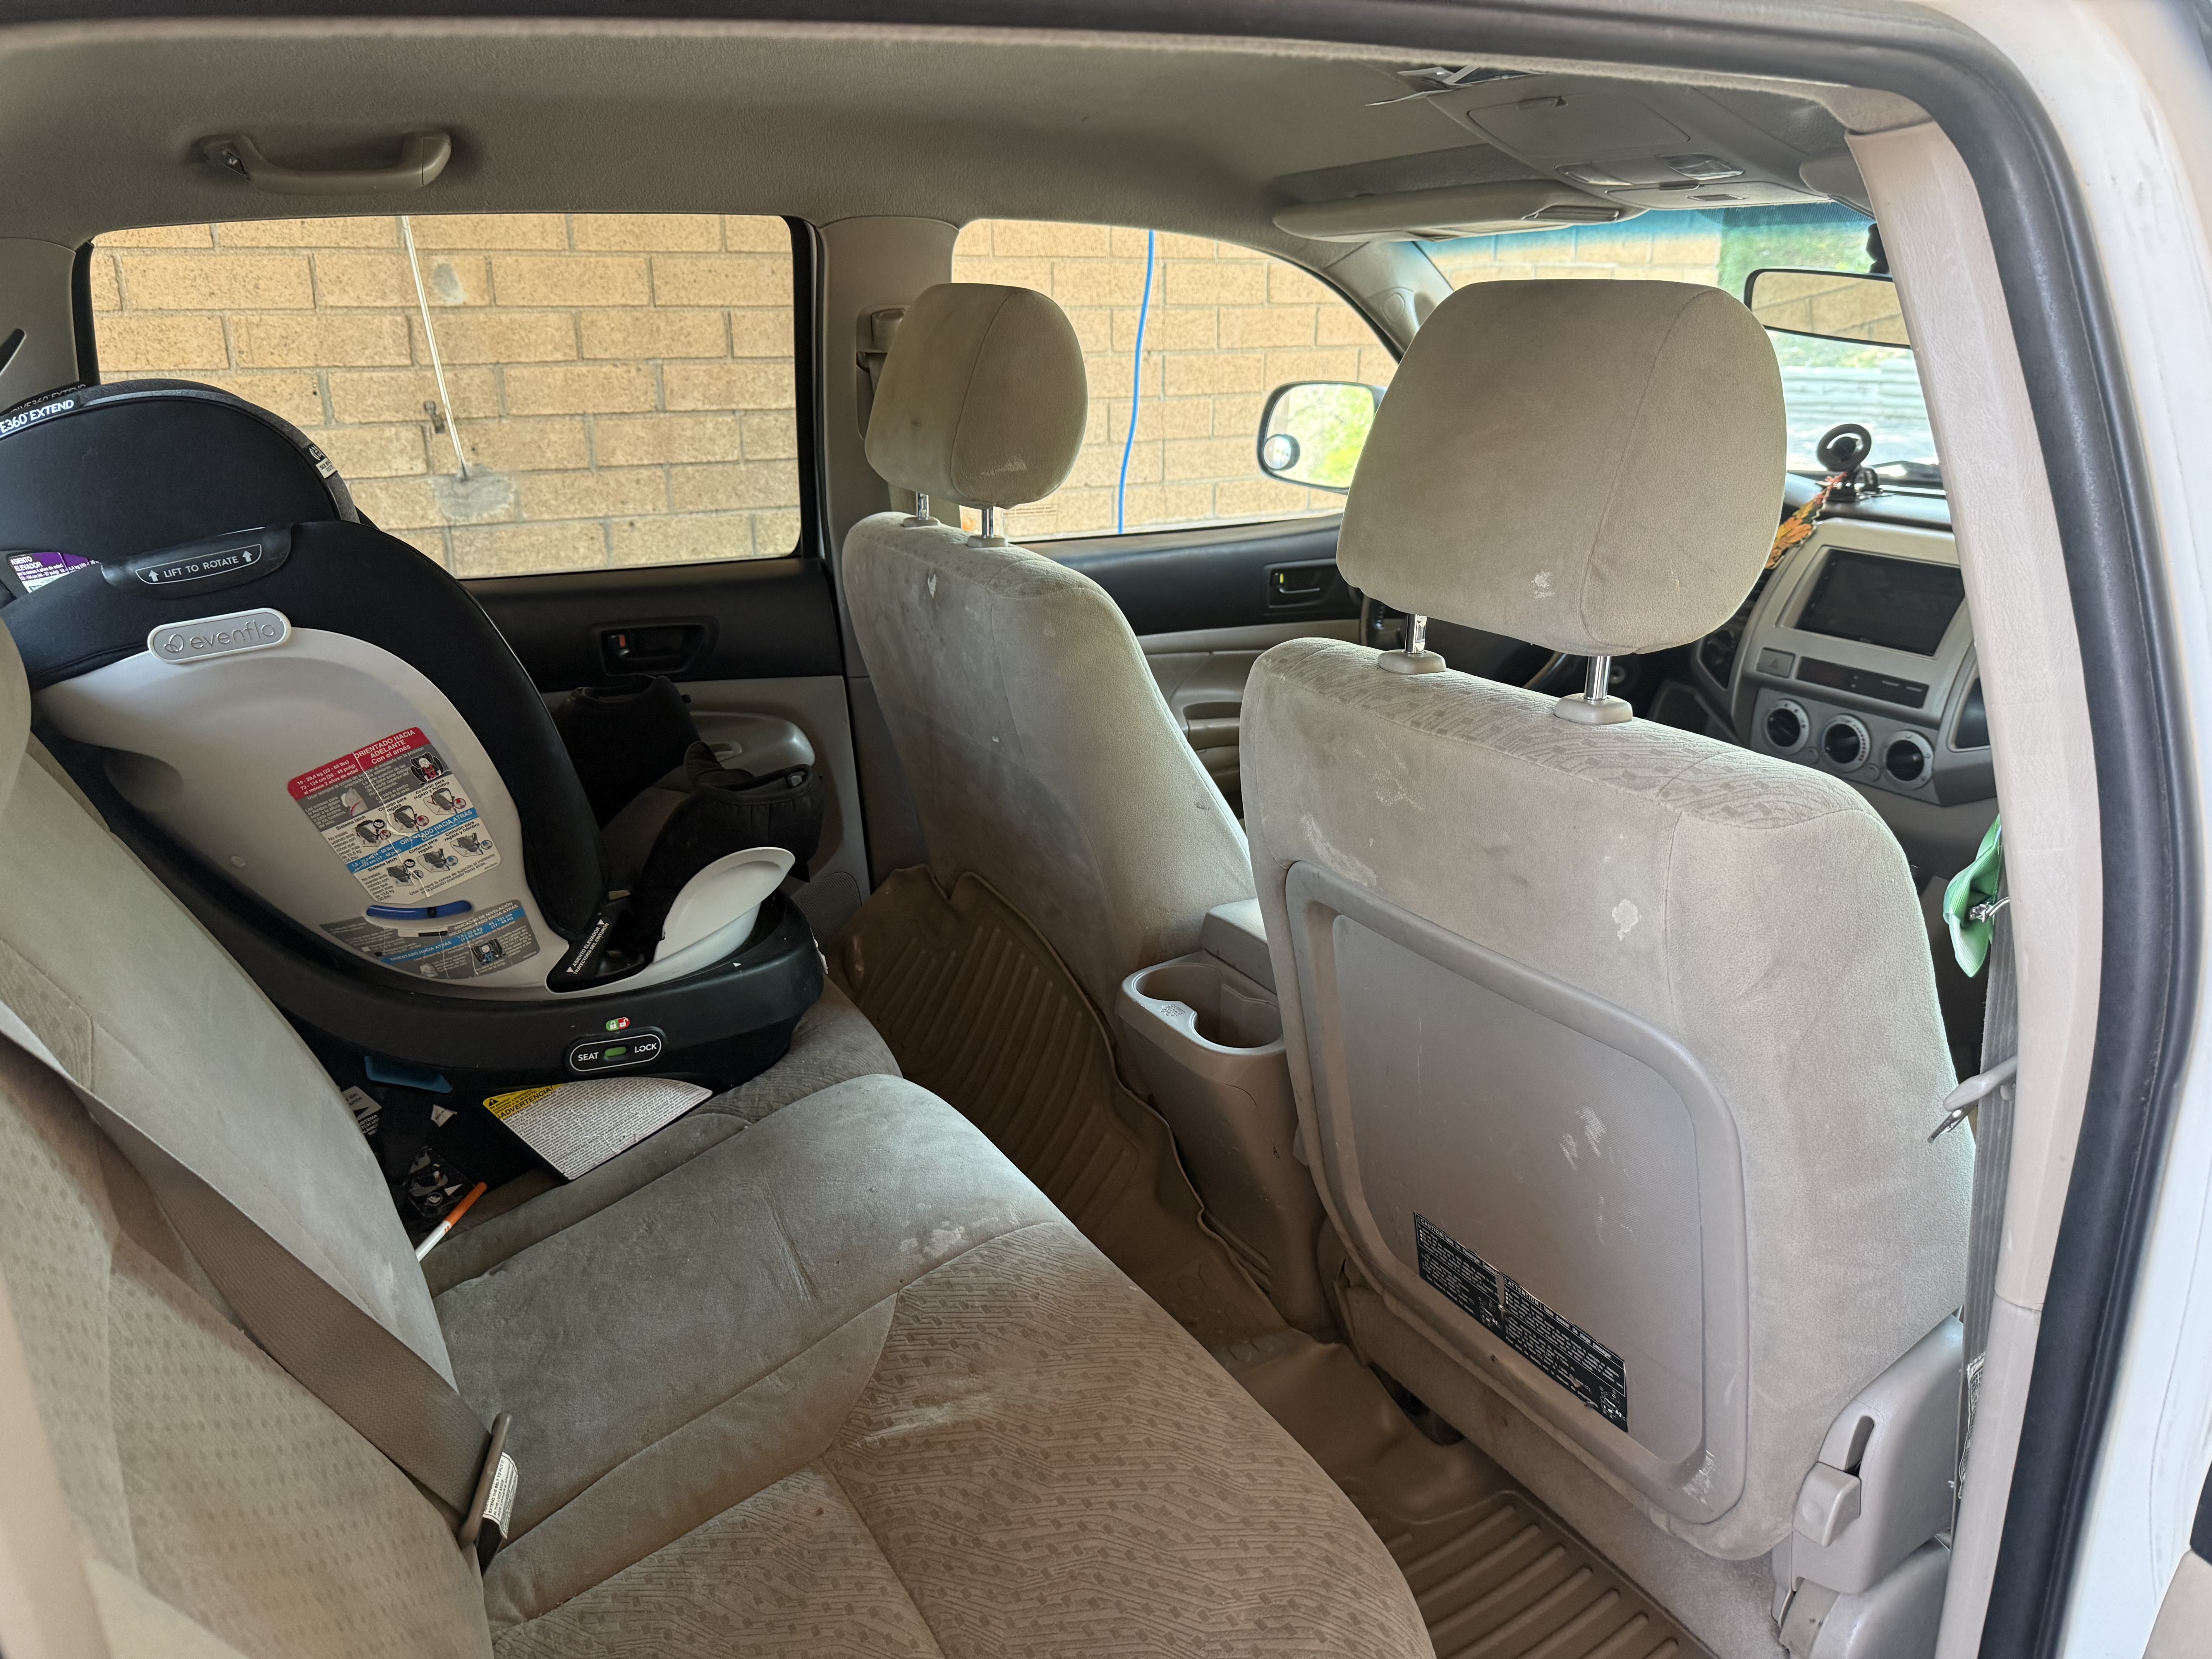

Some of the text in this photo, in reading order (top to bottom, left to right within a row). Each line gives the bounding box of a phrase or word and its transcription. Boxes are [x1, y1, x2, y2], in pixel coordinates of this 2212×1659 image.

[29, 400, 74, 421] EXTEND
[10, 555, 33, 565] ASIENTO
[14, 560, 43, 572] ELEVADOR
[164, 556, 239, 578] LIFT TO ROTATE
[190, 620, 275, 649] evenflo
[354, 729, 415, 758] ORIENTADO HACIA
[369, 739, 406, 758] ADELANTE
[371, 754, 385, 764] Con
[392, 744, 411, 755] arnés
[309, 783, 325, 792] menos
[346, 768, 359, 776] edad
[415, 783, 434, 794] Cinturón
[432, 781, 450, 790] hombro
[386, 804, 402, 812] regazo
[336, 820, 354, 830] Sistema
[433, 809, 472, 831] HACIA ATRÁS
[444, 832, 460, 842] regazo
[462, 822, 480, 832] hombro
[445, 825, 464, 836] Cinturón
[408, 843, 428, 854] Cinturón
[417, 845, 433, 854] regazo
[368, 862, 386, 871] Sistema
[485, 902, 513, 916] NIVELACIÓN
[488, 912, 502, 920] HACIA
[573, 927, 600, 967] ASIENTO ELEVADOR
[573, 950, 592, 974] TRAYECTORIA
[595, 922, 609, 942] CINTURÓN
[578, 1042, 657, 1061] SEAT LOCK
[1421, 1218, 1443, 1238] CAUTION
[1508, 1279, 1538, 1306] ATTENTION
